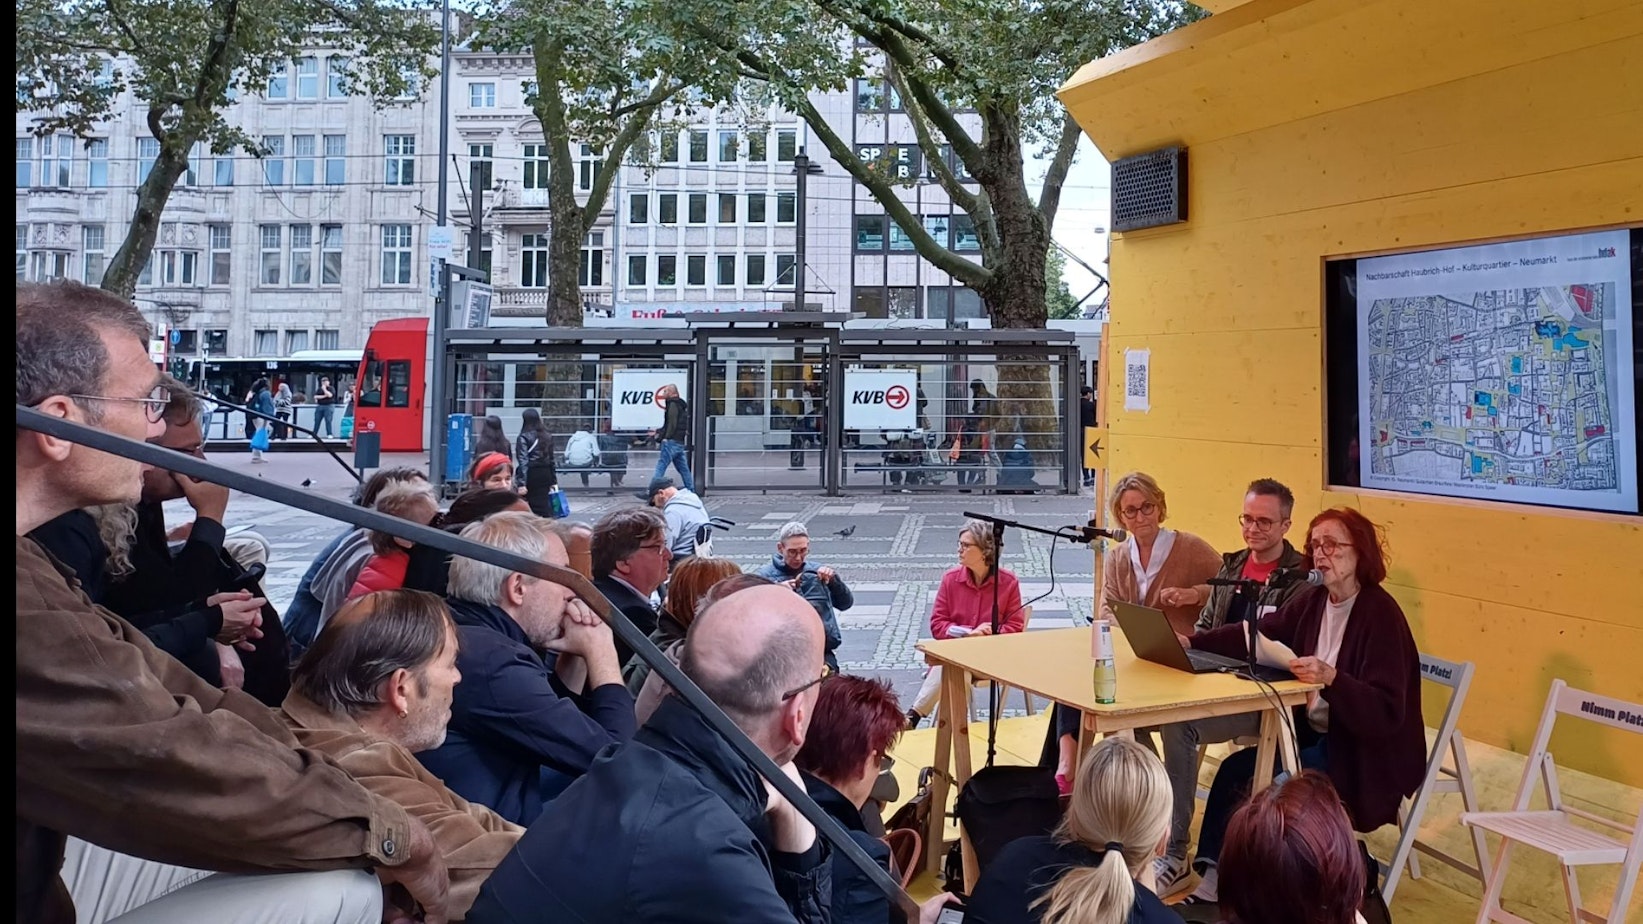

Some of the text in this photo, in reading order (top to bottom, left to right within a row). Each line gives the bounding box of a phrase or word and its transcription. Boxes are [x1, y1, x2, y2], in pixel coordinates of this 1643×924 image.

[1366, 271, 1410, 280] Nachbarschaft
[1411, 265, 1455, 277] Haubrich-Hof
[1462, 260, 1511, 272] Kulturquartier
[1519, 255, 1557, 266] Neumarkt
[620, 391, 654, 405] KVB
[852, 391, 884, 405] KVB
[1581, 701, 1615, 719] Nimm
